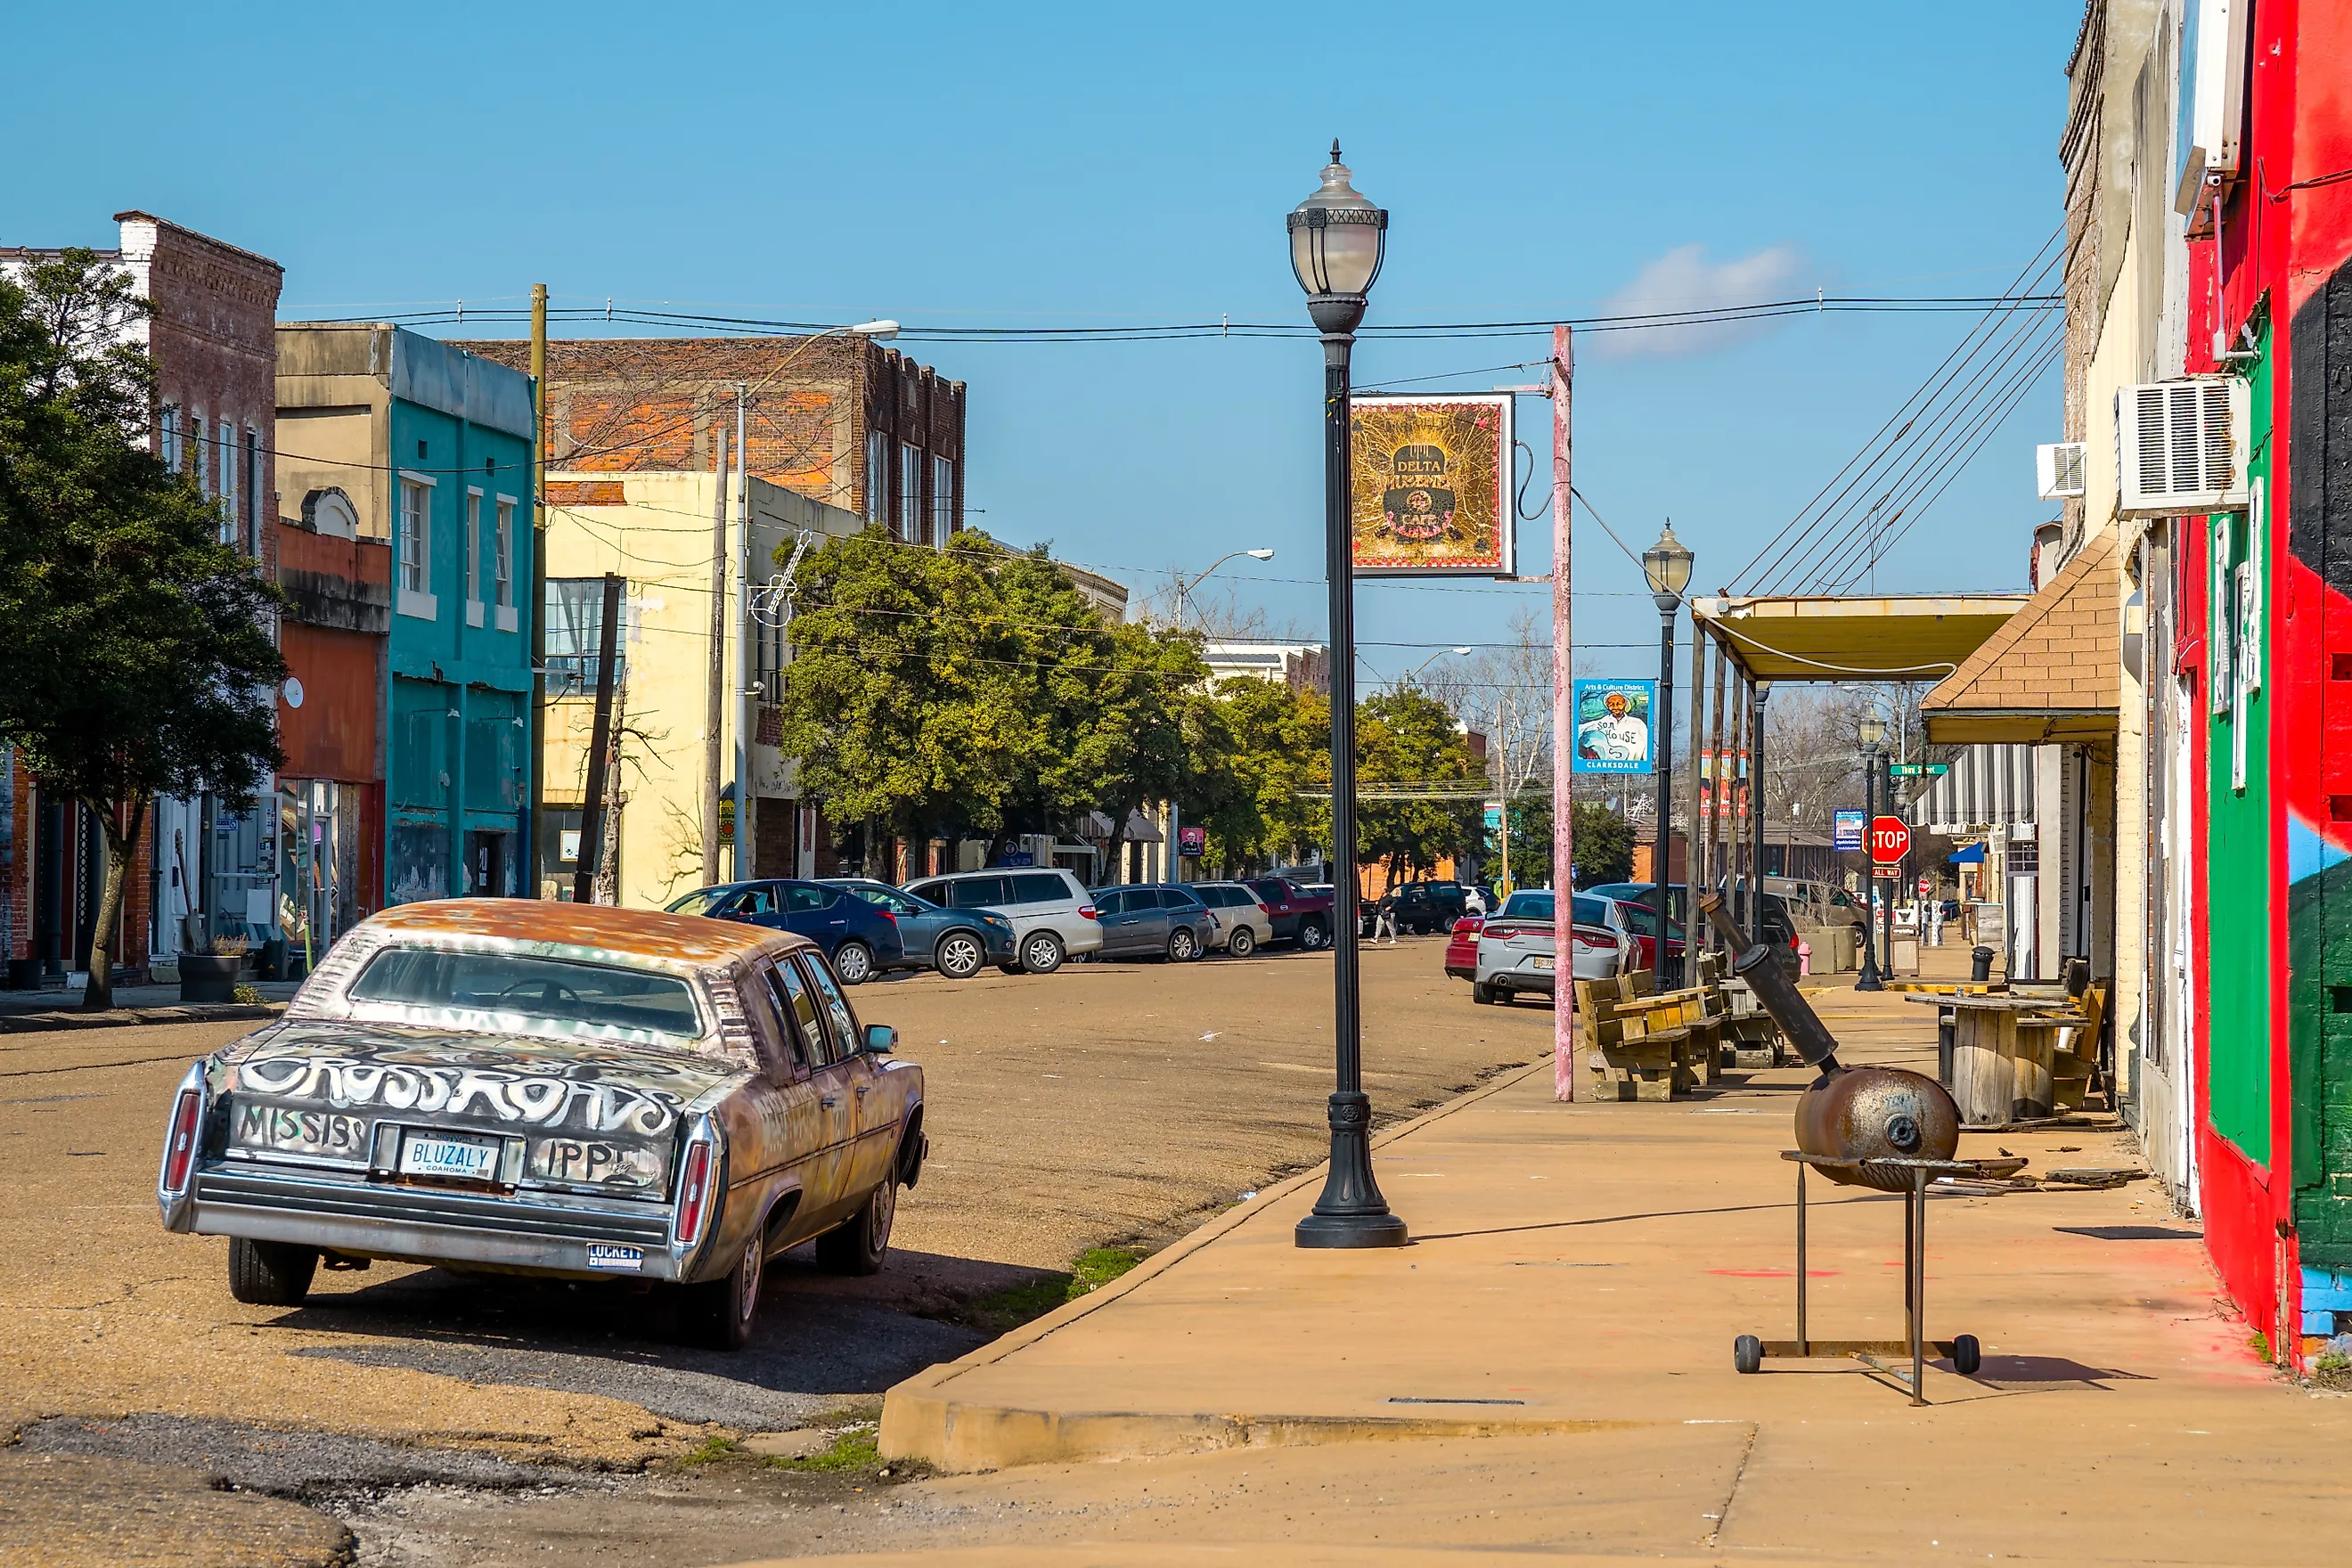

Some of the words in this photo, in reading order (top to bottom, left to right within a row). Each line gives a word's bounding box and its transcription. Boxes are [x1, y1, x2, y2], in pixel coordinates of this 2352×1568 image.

[1397, 461, 1441, 472] DELTA
[1586, 761, 1639, 769] CLARKSDALE
[1901, 766, 1915, 774] Third
[241, 1058, 684, 1136] CROSSROADS
[412, 1143, 489, 1168] BLUZALY
[426, 1165, 467, 1173] COAHOMA
[590, 1245, 641, 1259] LUCKETT
